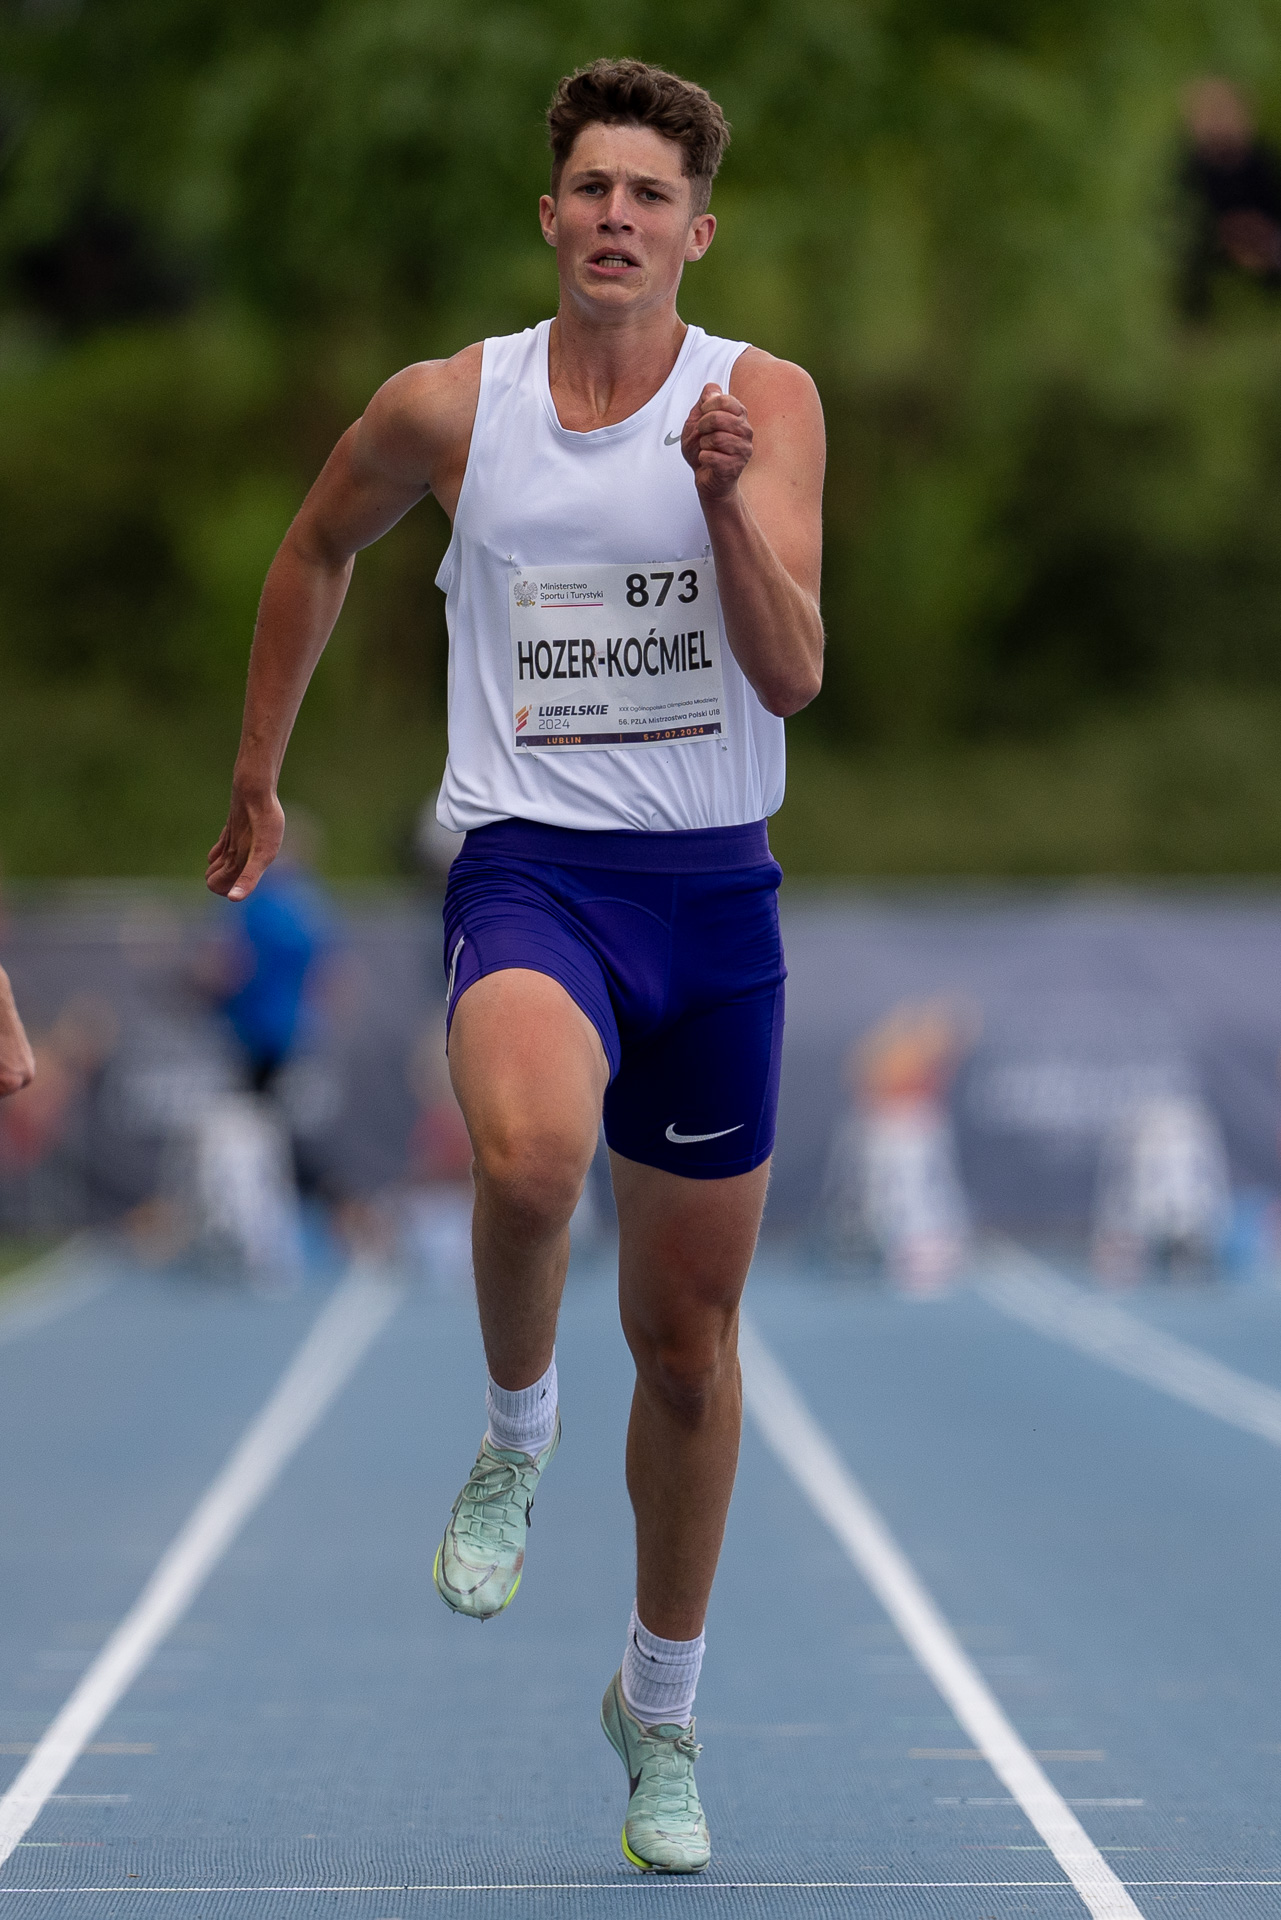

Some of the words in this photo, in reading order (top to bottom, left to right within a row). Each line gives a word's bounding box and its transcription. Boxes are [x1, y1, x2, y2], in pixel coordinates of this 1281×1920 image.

[540, 582, 588, 590] Ministerstwo
[625, 569, 699, 608] 873
[540, 592, 565, 601] Sportu
[570, 590, 604, 600] Turystyki
[517, 628, 713, 680] HOZER-KOĆMIEL
[538, 704, 609, 717] LUBELSKIE
[667, 700, 693, 709] Olimpiada
[648, 714, 688, 724] Mistrzostwa
[688, 710, 708, 719] Polski
[708, 708, 721, 716] U18
[538, 718, 571, 730] 2024
[546, 736, 582, 745] LUBLIN
[643, 727, 704, 741] 5-7.07.2024
